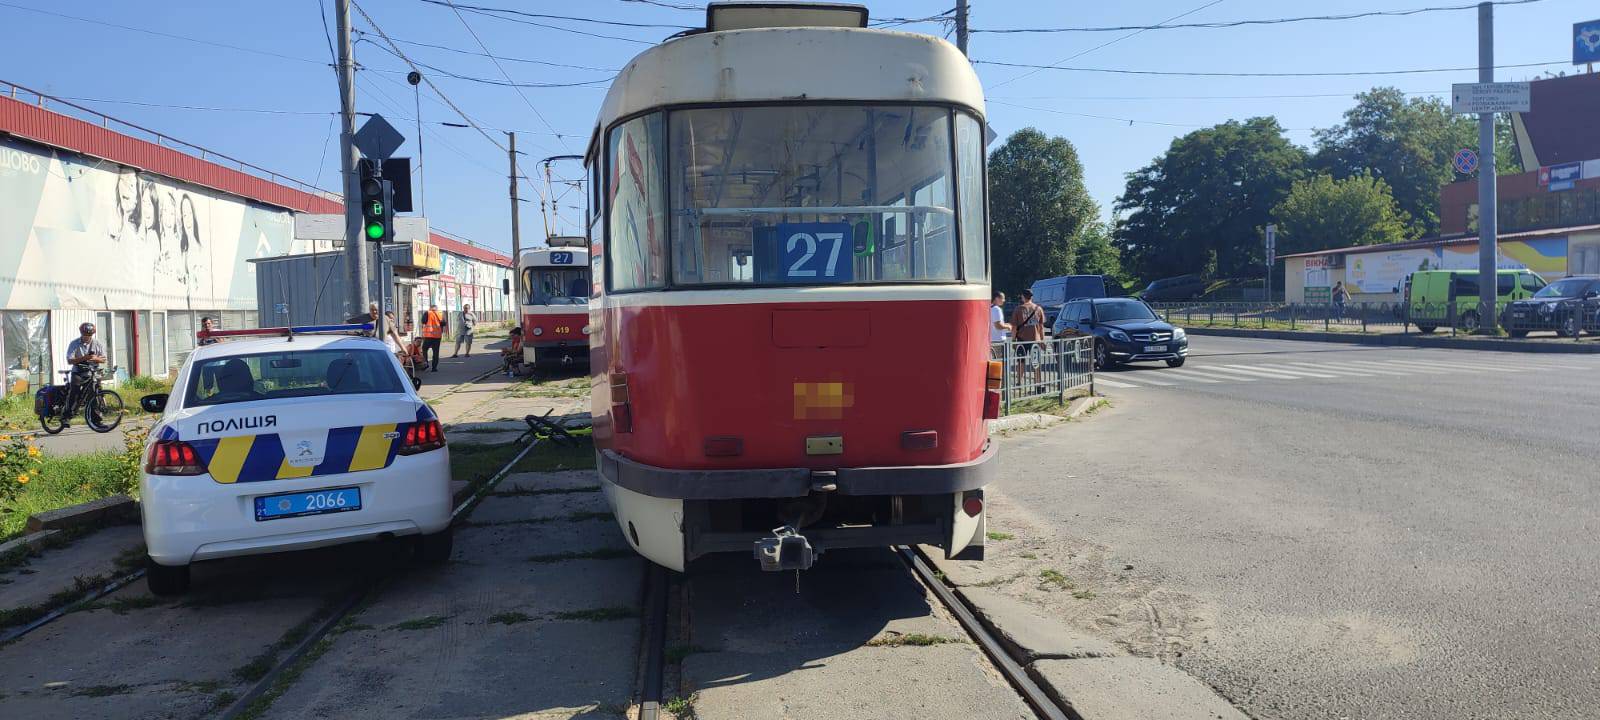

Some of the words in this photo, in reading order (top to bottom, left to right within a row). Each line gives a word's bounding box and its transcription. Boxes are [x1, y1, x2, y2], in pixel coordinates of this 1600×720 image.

[553, 253, 569, 263] 27
[786, 232, 844, 277] 27
[555, 326, 570, 334] 419
[197, 414, 277, 435] ПОЛІЦІЯ
[305, 491, 346, 511] 2066
